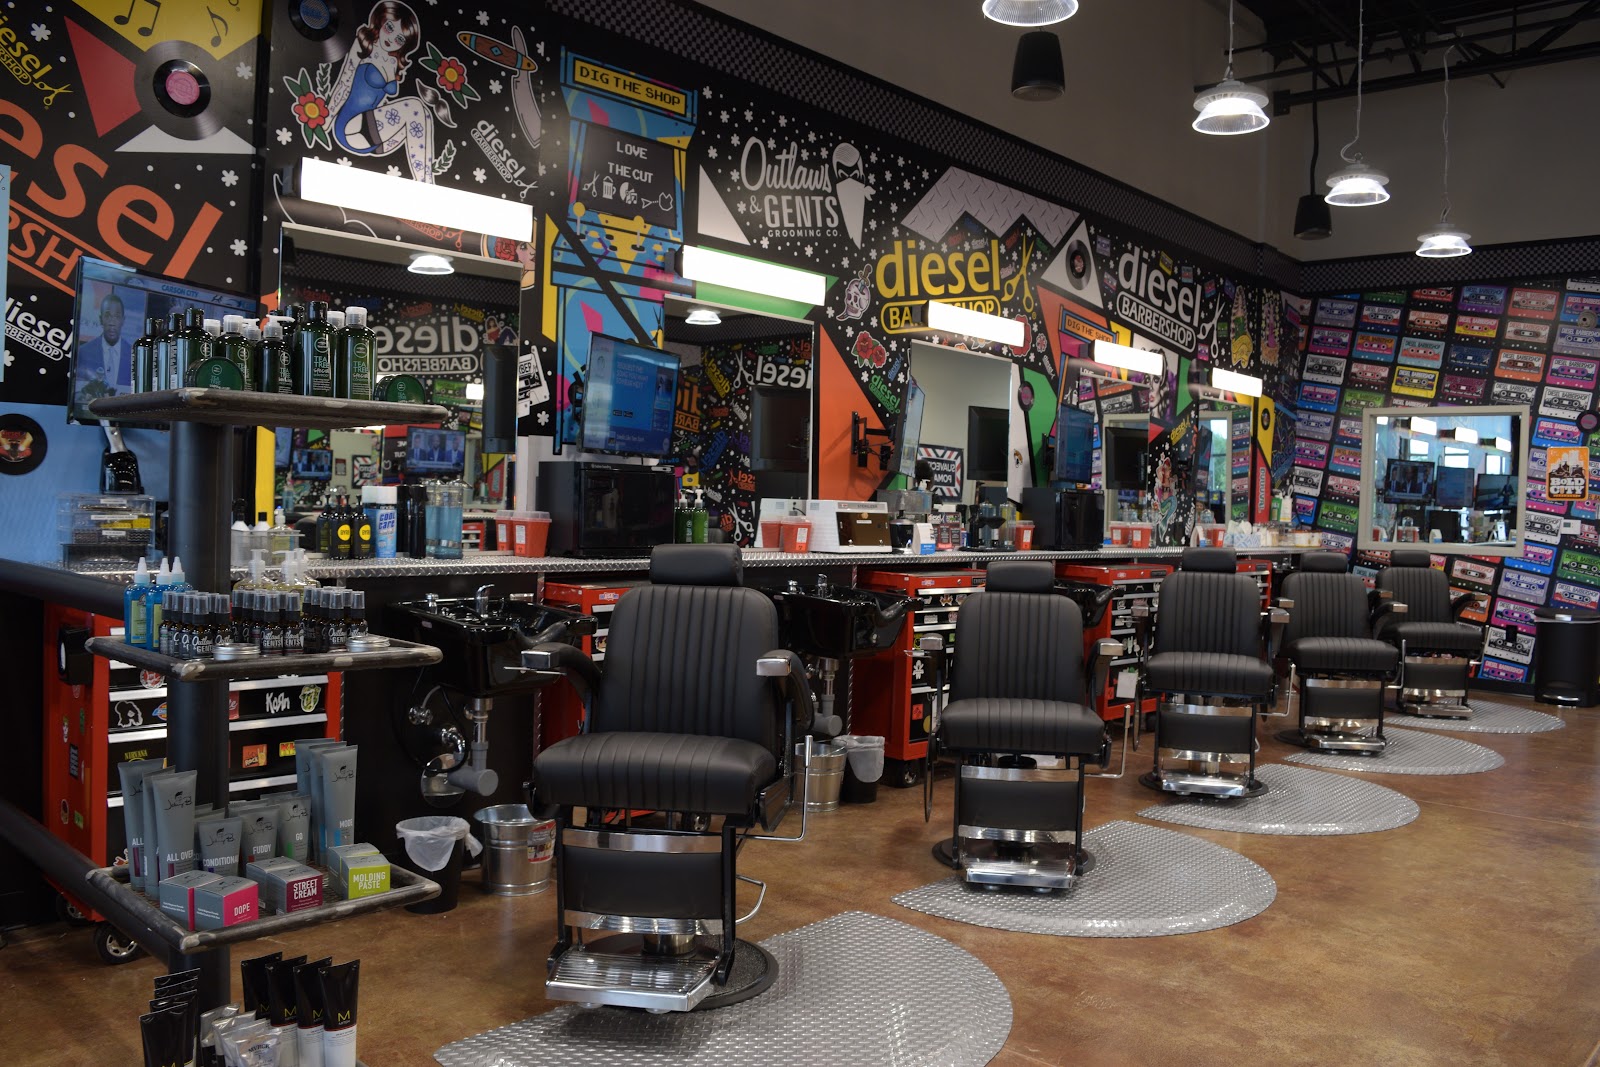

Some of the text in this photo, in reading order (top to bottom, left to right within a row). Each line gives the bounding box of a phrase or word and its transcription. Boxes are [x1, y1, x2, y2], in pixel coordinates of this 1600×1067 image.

[579, 66, 681, 106] DIG THE SHOP
[477, 120, 525, 178] diesel
[616, 140, 648, 160] LOVE
[473, 131, 512, 181] BARBERSHOP
[740, 136, 832, 192] Outlaws
[607, 162, 654, 184] THE CUT
[749, 194, 840, 228] & GENTS
[768, 229, 841, 238] GROOMING CO.
[876, 239, 1000, 298] diesel
[161, 284, 199, 298] CARSON CITY
[1118, 245, 1202, 328] diesel
[1067, 318, 1080, 331] DIG
[1081, 325, 1094, 338] THE
[1121, 296, 1193, 347] BARBERSHOP
[313, 361, 330, 369] TREE
[871, 374, 901, 409] diesel
[1550, 478, 1585, 486] BOLD
[1550, 485, 1585, 495] CITY
[124, 749, 148, 760] NIRVANA
[132, 838, 144, 846] ALL
[295, 832, 304, 841] GO
[253, 844, 272, 855] FUDDY
[166, 853, 179, 862] ALL
[353, 872, 386, 884] MOLDING
[293, 879, 318, 892] STREET
[358, 880, 381, 891] PASTE
[294, 889, 318, 900] CREAM
[234, 902, 251, 917] DOPE
[284, 1006, 297, 1017] M
[337, 1010, 351, 1022] M
